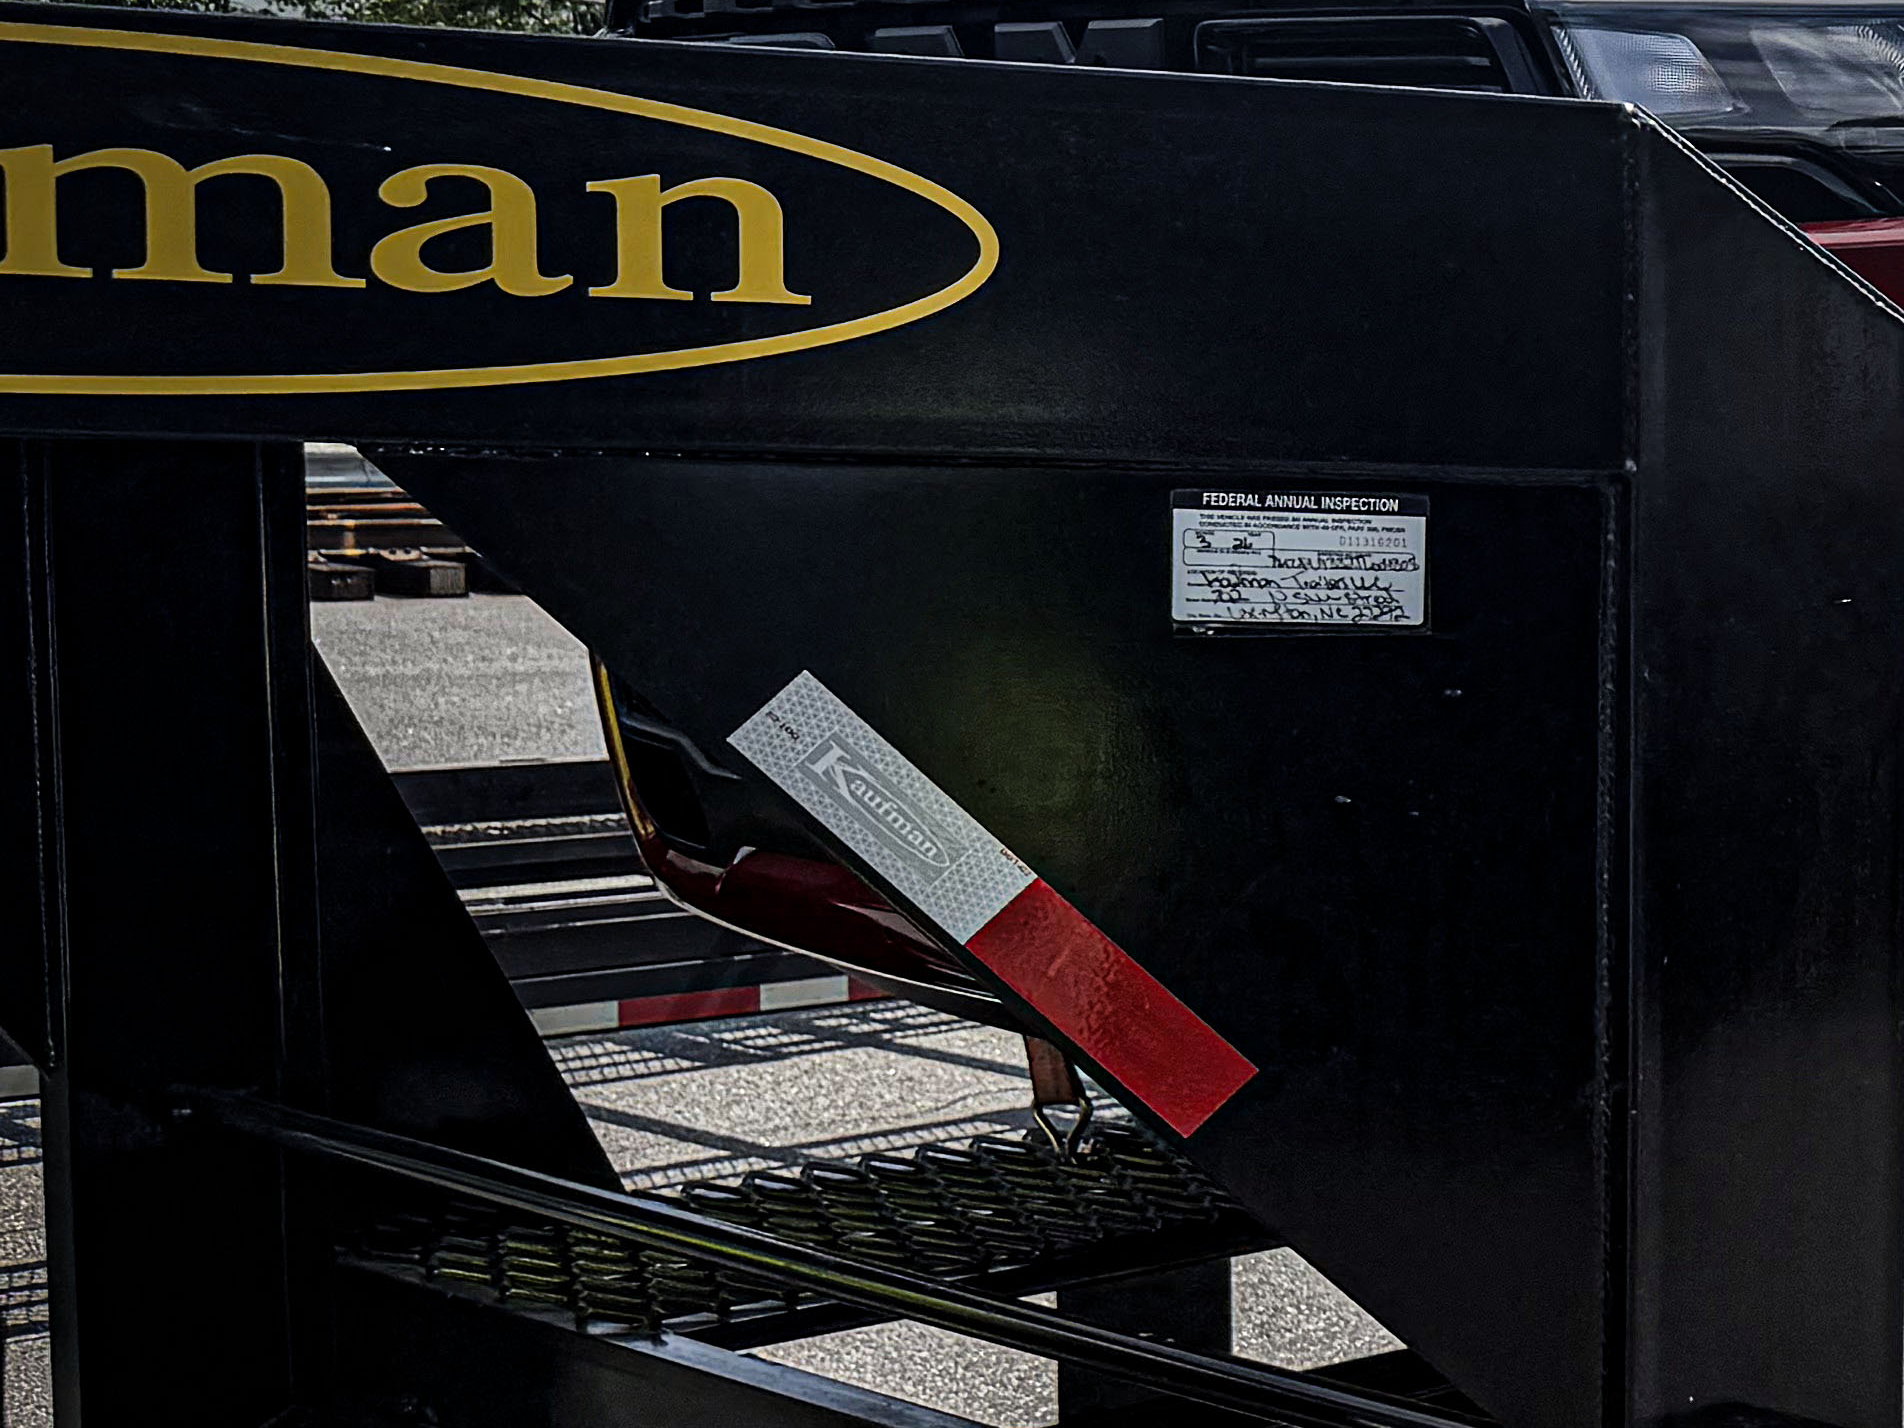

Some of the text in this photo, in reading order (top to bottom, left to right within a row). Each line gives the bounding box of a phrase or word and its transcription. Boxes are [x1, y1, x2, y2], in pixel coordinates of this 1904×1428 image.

[1202, 492, 1399, 512] FEDERAL ANNUAL INSPECTION
[811, 739, 941, 860] Kaufman
